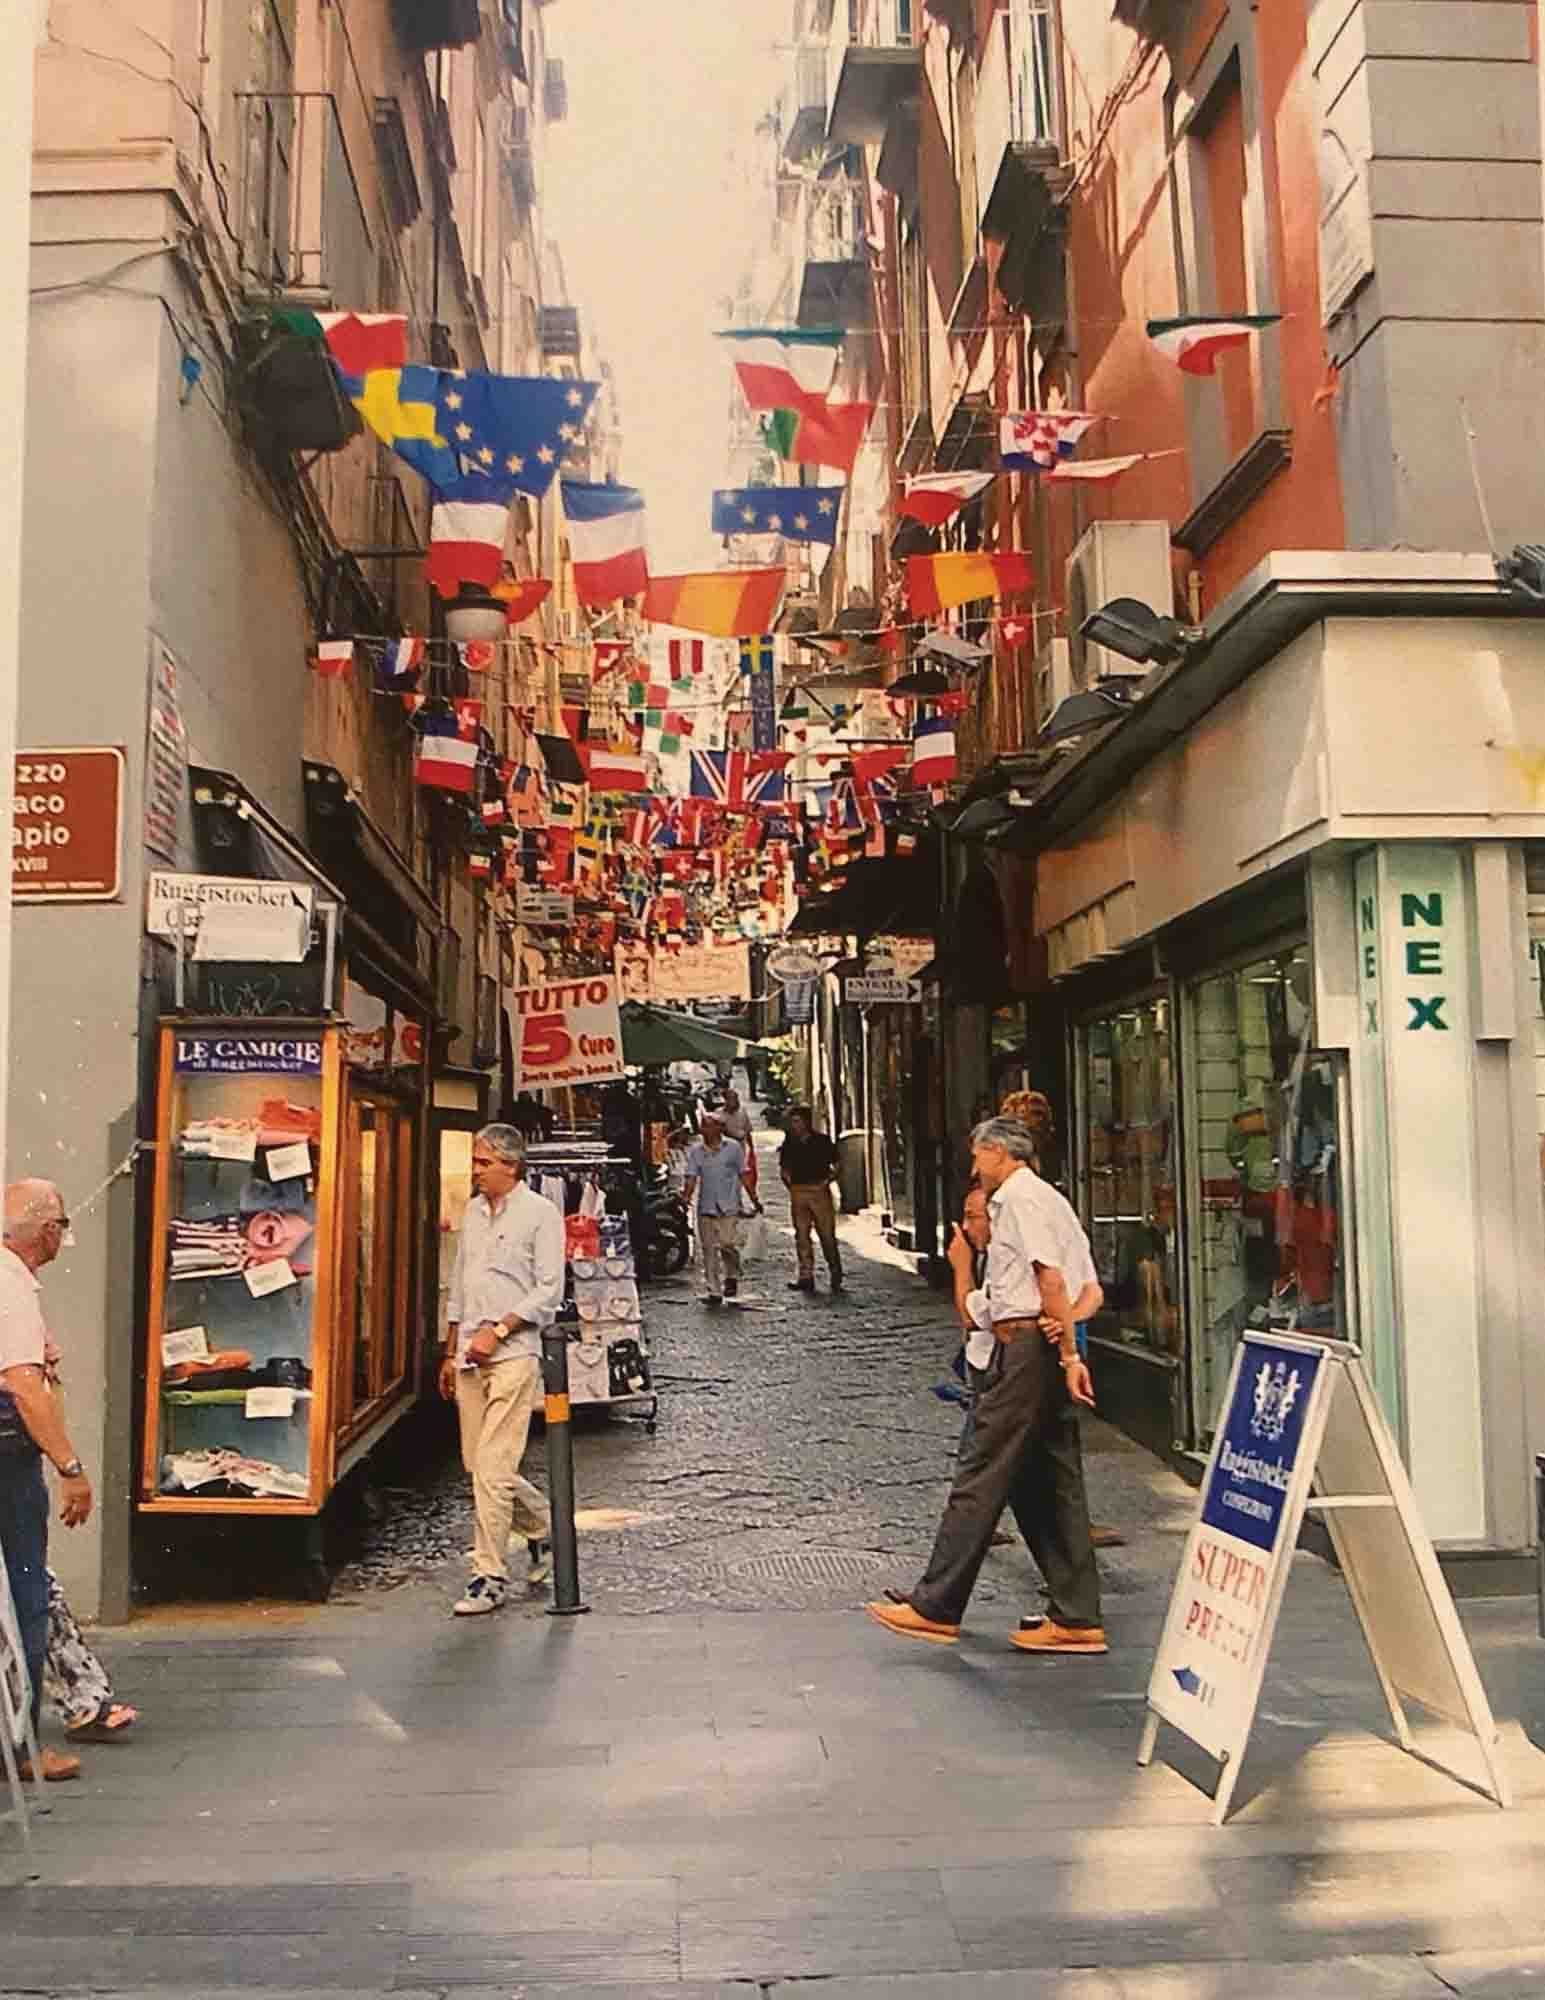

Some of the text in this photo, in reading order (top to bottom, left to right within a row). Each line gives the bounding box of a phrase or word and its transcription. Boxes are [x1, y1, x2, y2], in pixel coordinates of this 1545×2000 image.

[1361, 896, 1379, 1034] NEX
[1401, 893, 1449, 1030] NEX
[514, 981, 608, 1014] TUTTO
[178, 1040, 321, 1064] LE CAMICIE
[522, 1014, 571, 1066] 5
[1191, 1542, 1267, 1607] SUPER
